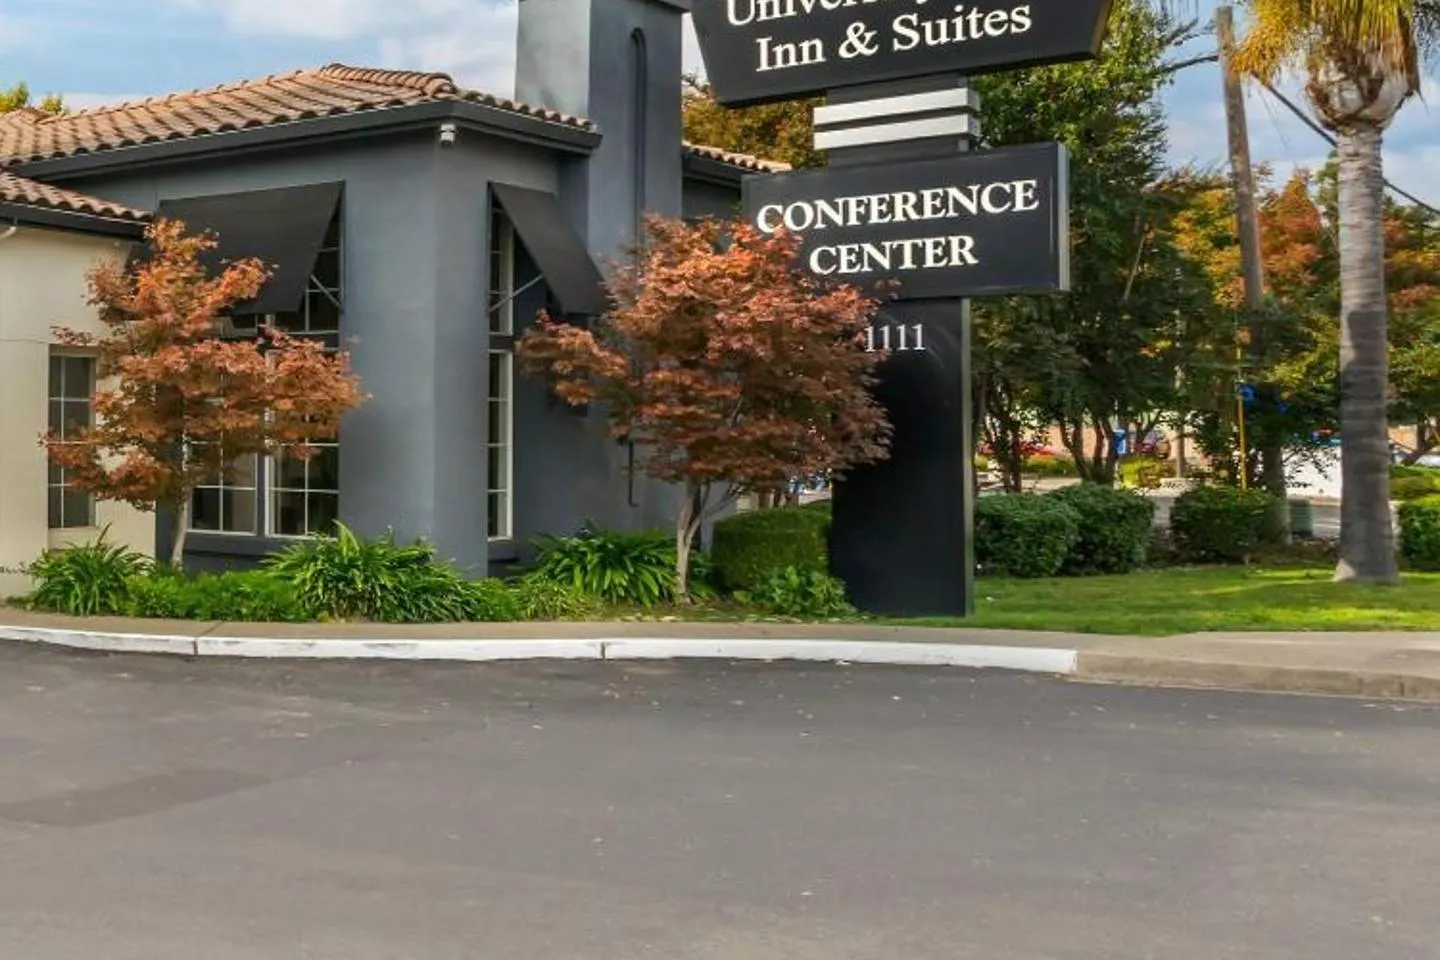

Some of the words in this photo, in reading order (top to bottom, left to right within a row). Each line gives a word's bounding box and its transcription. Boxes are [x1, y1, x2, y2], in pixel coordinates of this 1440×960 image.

[756, 35, 826, 72] Inn
[838, 22, 878, 57] &
[893, 3, 1032, 52] Suites
[757, 179, 1040, 234] CONFERENCE
[809, 236, 979, 276] CENTER
[864, 324, 927, 352] 1111
